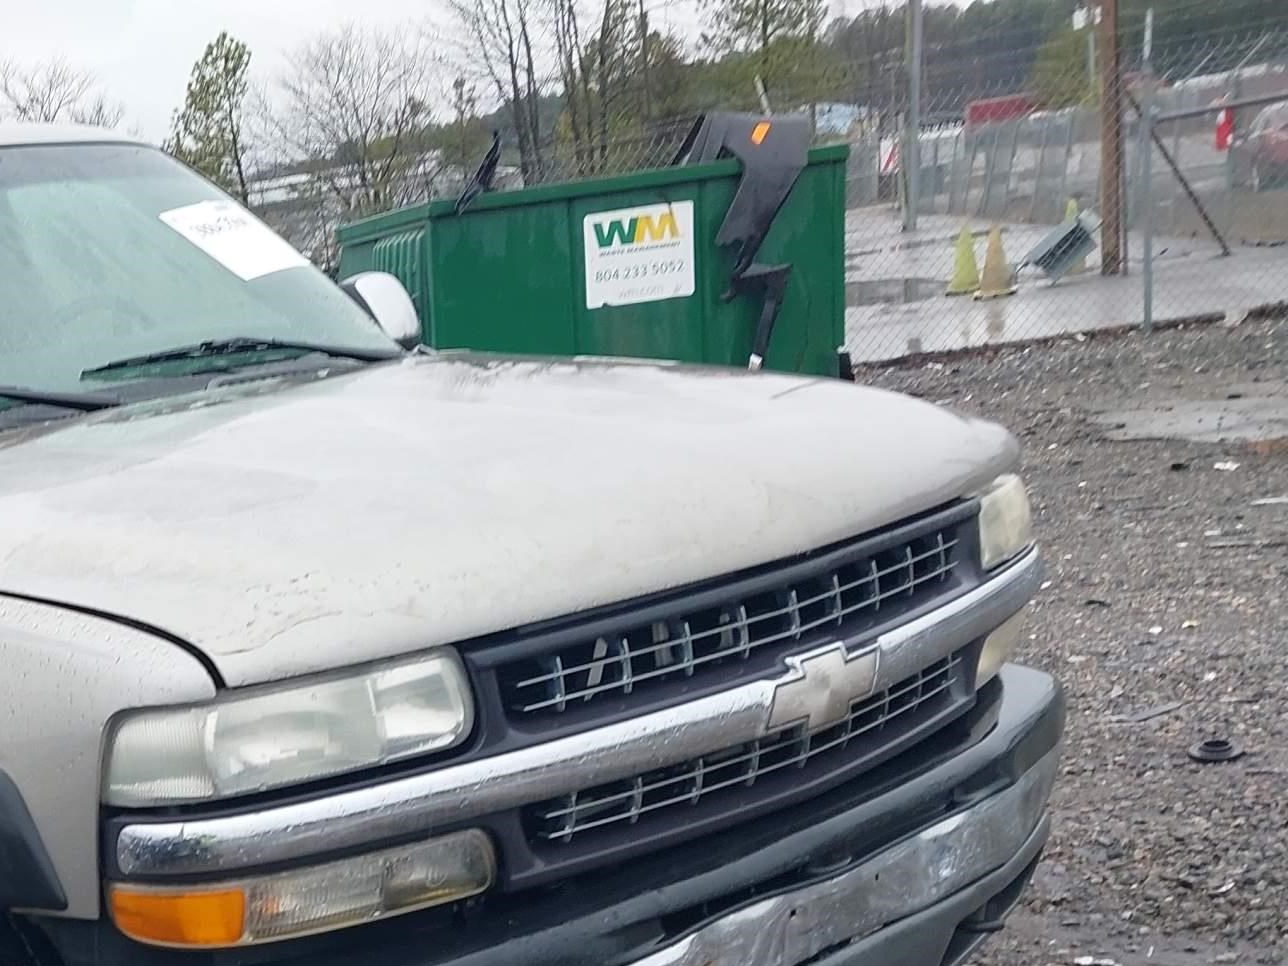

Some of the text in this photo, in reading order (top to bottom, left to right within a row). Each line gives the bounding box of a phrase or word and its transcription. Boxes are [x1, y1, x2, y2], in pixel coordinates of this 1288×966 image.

[593, 211, 680, 248] WM
[595, 259, 686, 283] 804 233 5052
